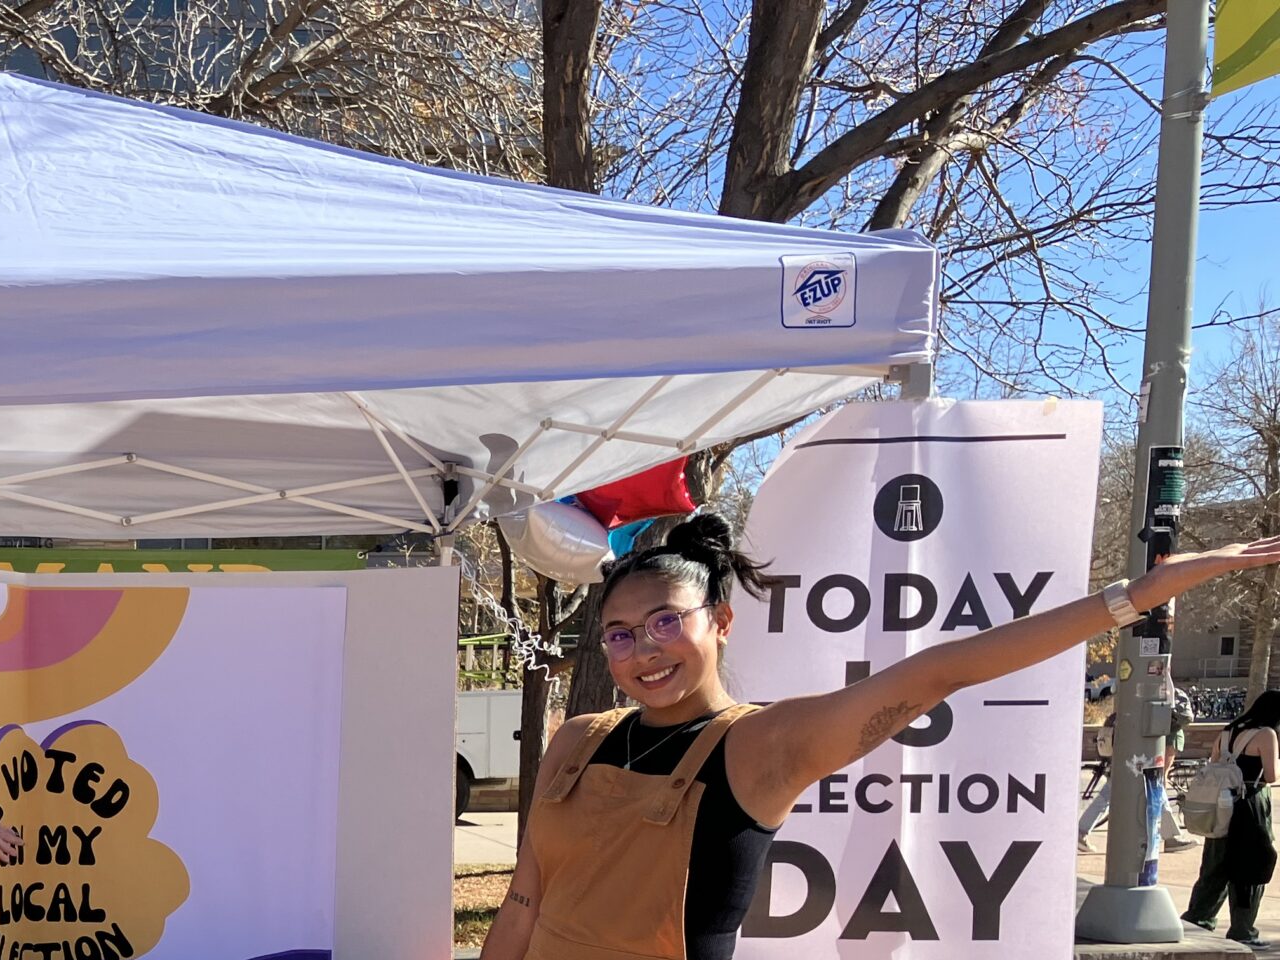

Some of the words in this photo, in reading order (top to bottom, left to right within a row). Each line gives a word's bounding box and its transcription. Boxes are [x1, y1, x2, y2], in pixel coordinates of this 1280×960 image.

[766, 571, 1055, 633] TODAY
[1, 749, 130, 818] VOTED
[790, 773, 1046, 814] ECTION
[36, 825, 102, 865] MY
[741, 838, 1043, 942] DAY
